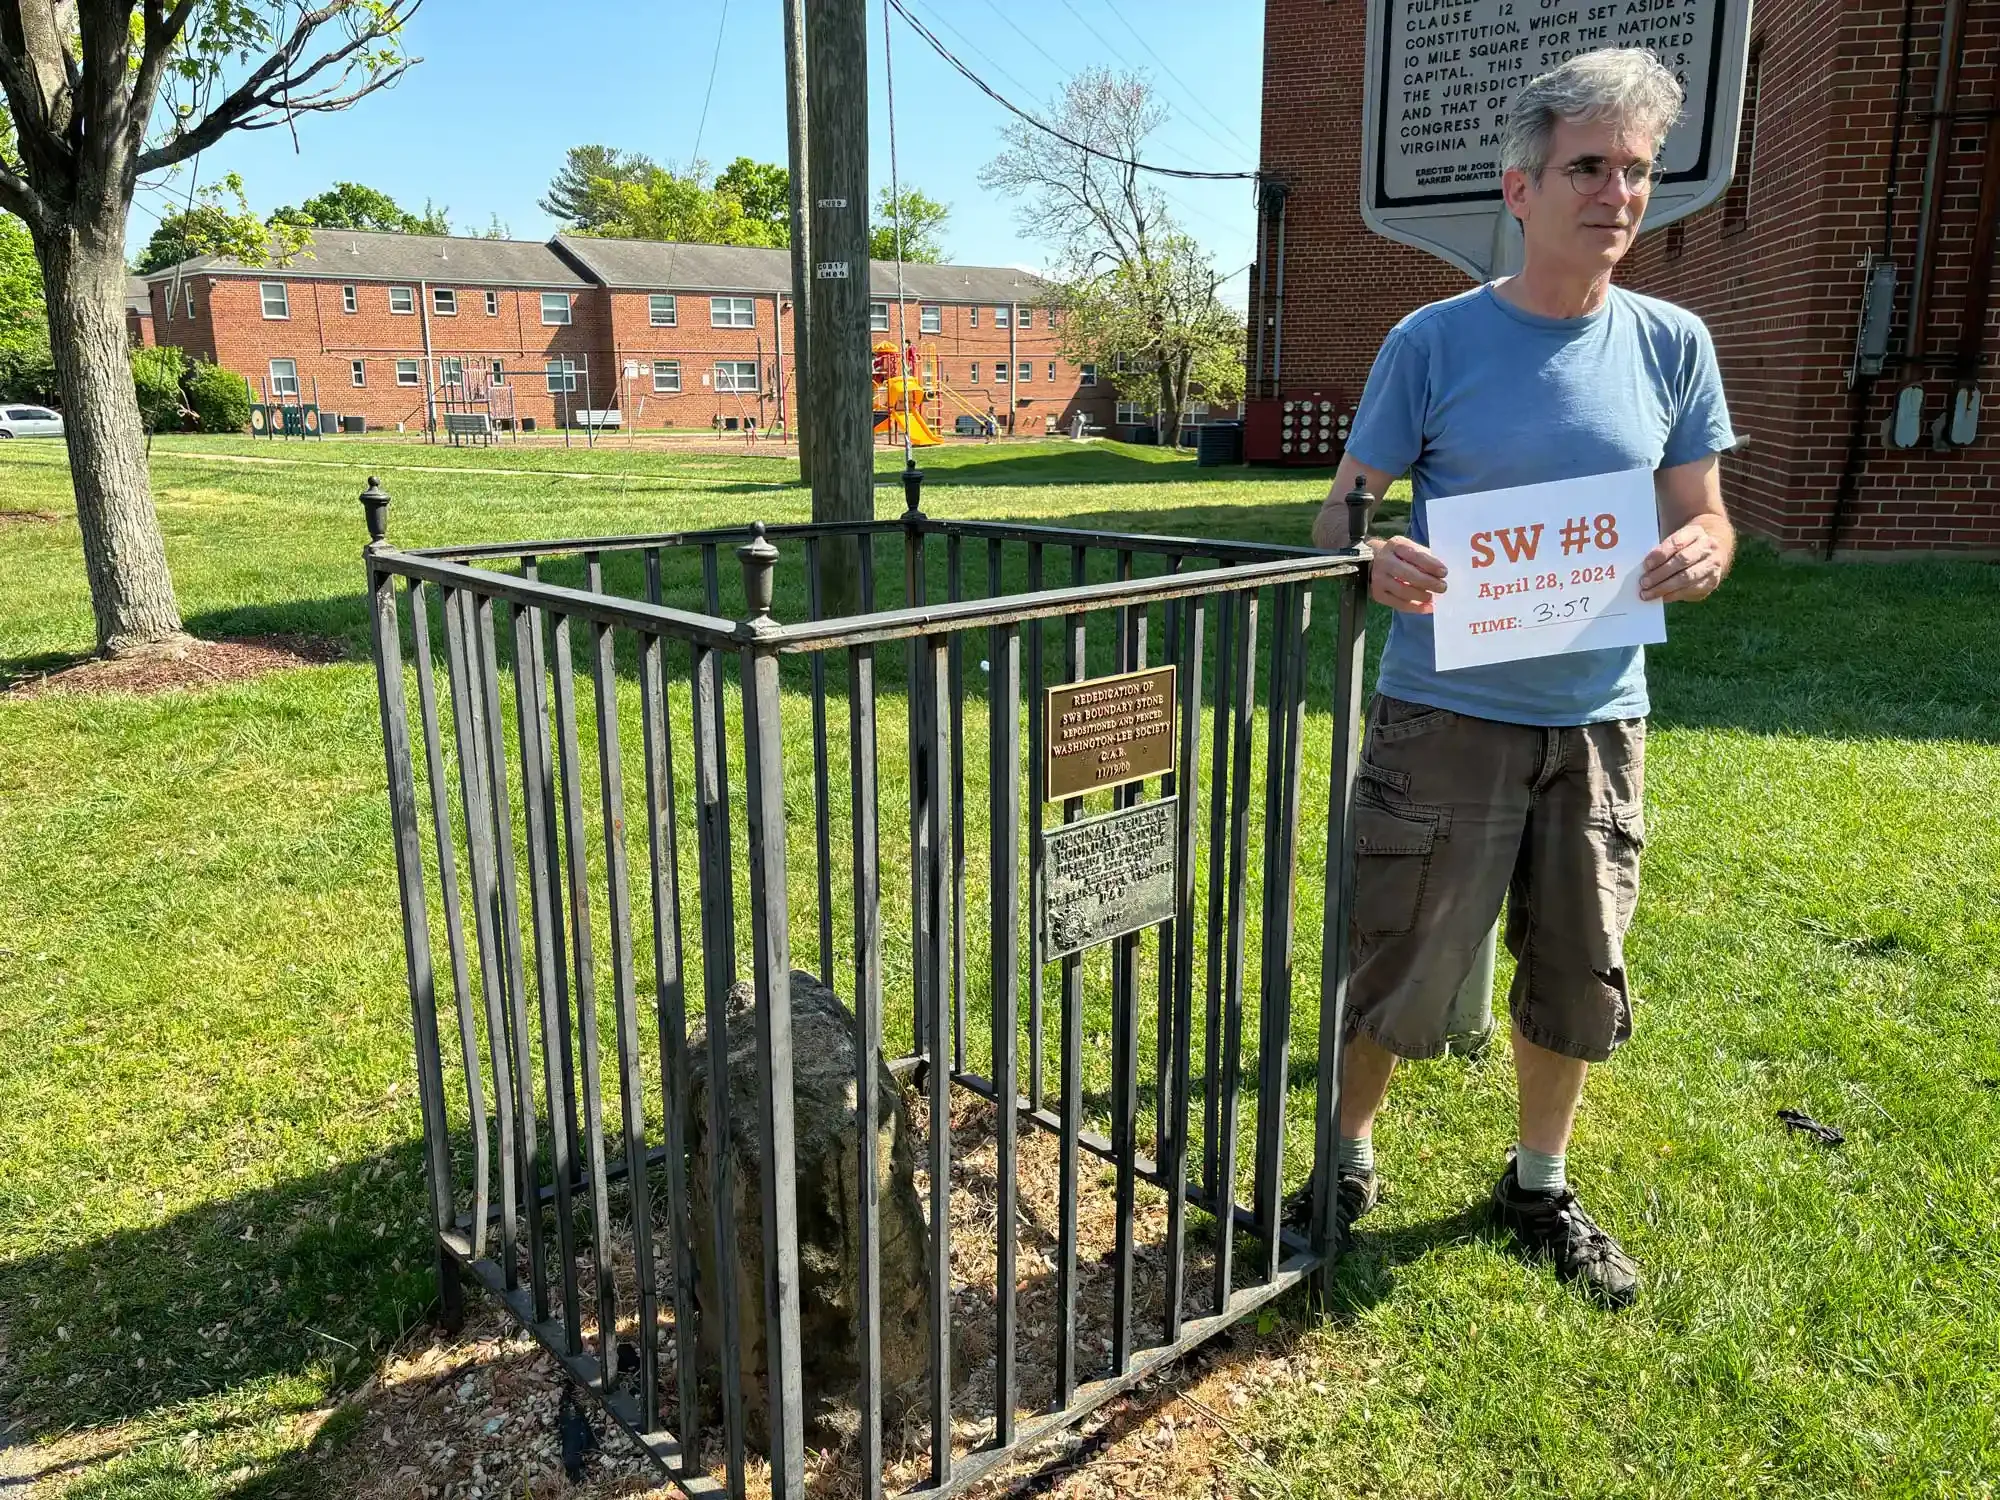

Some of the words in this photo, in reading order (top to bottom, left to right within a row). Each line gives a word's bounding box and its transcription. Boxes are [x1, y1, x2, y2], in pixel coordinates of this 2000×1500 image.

[1406, 10, 1472, 32] CLAUSE
[1498, 3, 1513, 17] 12
[1407, 0, 1480, 15] FULFILL
[1405, 21, 1520, 50] CONSTITUTION,
[1529, 11, 1578, 31] WHICH
[1587, 4, 1618, 21] SET
[1626, 0, 1675, 15] ASIDE
[1404, 55, 1419, 69] 10
[1428, 49, 1461, 64] MILE
[1469, 38, 1529, 58] SQUARE
[1538, 31, 1570, 48] FOR
[1578, 26, 1607, 42] THE
[1617, 12, 1695, 35] NATION'S
[1403, 66, 1473, 86] CAPITAL.
[1487, 57, 1522, 74] THIS
[1618, 32, 1694, 51] MARKED
[1403, 89, 1430, 103] THE
[1443, 73, 1544, 98] JURISDICTI
[1401, 106, 1431, 121] AND
[1440, 100, 1477, 116] THAT
[1487, 96, 1507, 109] OF
[1400, 117, 1480, 138] CONGRESS
[1400, 137, 1466, 155] VIRGINIA
[1415, 165, 1454, 177] ERECTED
[1458, 164, 1468, 173] IN
[1417, 174, 1451, 186] MARKER
[1454, 170, 1496, 182] DONATED
[1470, 523, 1544, 569] SW
[1559, 513, 1619, 556] #8
[1477, 577, 1530, 601] April
[1535, 574, 1564, 591] 28,
[1570, 565, 1615, 586] 2024
[1468, 617, 1523, 636] TIME:
[1073, 682, 1140, 707] REDEDICATION
[1143, 680, 1155, 692] OF
[1084, 701, 1133, 720] BOUNDARY
[1136, 694, 1164, 709] STONE
[1062, 720, 1117, 739] REPOSITIONED
[1118, 716, 1134, 727] AND
[1136, 709, 1163, 724] FENCED
[1052, 730, 1133, 756] WASHINGTON-LEE
[1135, 721, 1171, 738] SOCIETY
